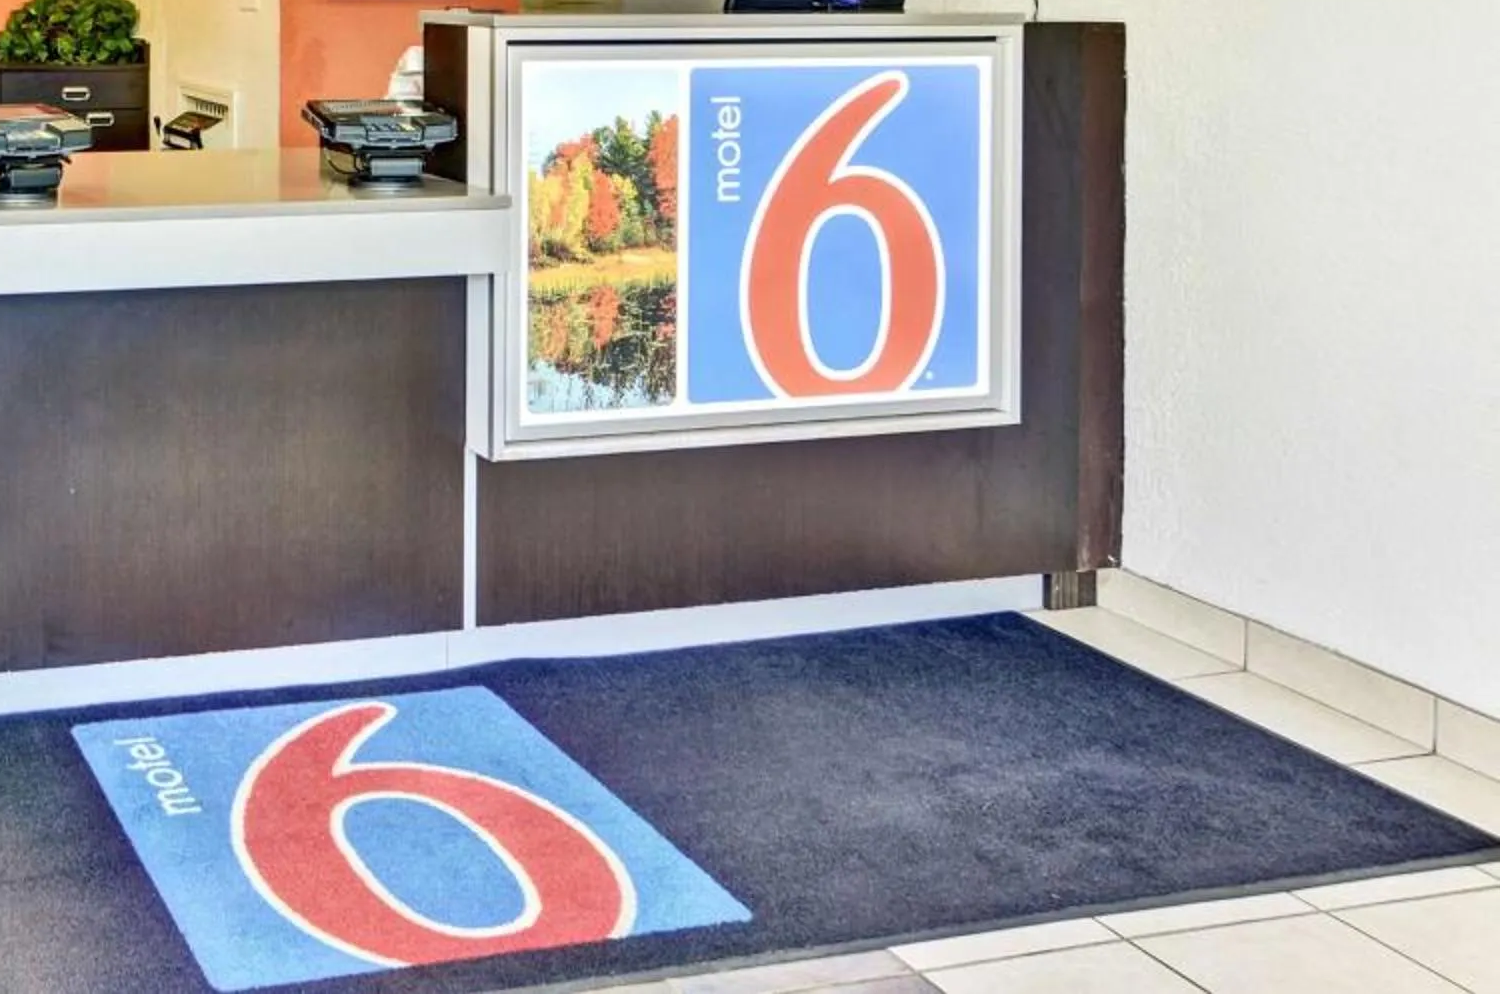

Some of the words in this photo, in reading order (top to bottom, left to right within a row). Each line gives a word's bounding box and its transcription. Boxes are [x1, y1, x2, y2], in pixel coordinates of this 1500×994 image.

[710, 96, 741, 203] motel
[739, 70, 946, 401] 6
[113, 737, 202, 817] motel
[230, 701, 638, 968] 6
